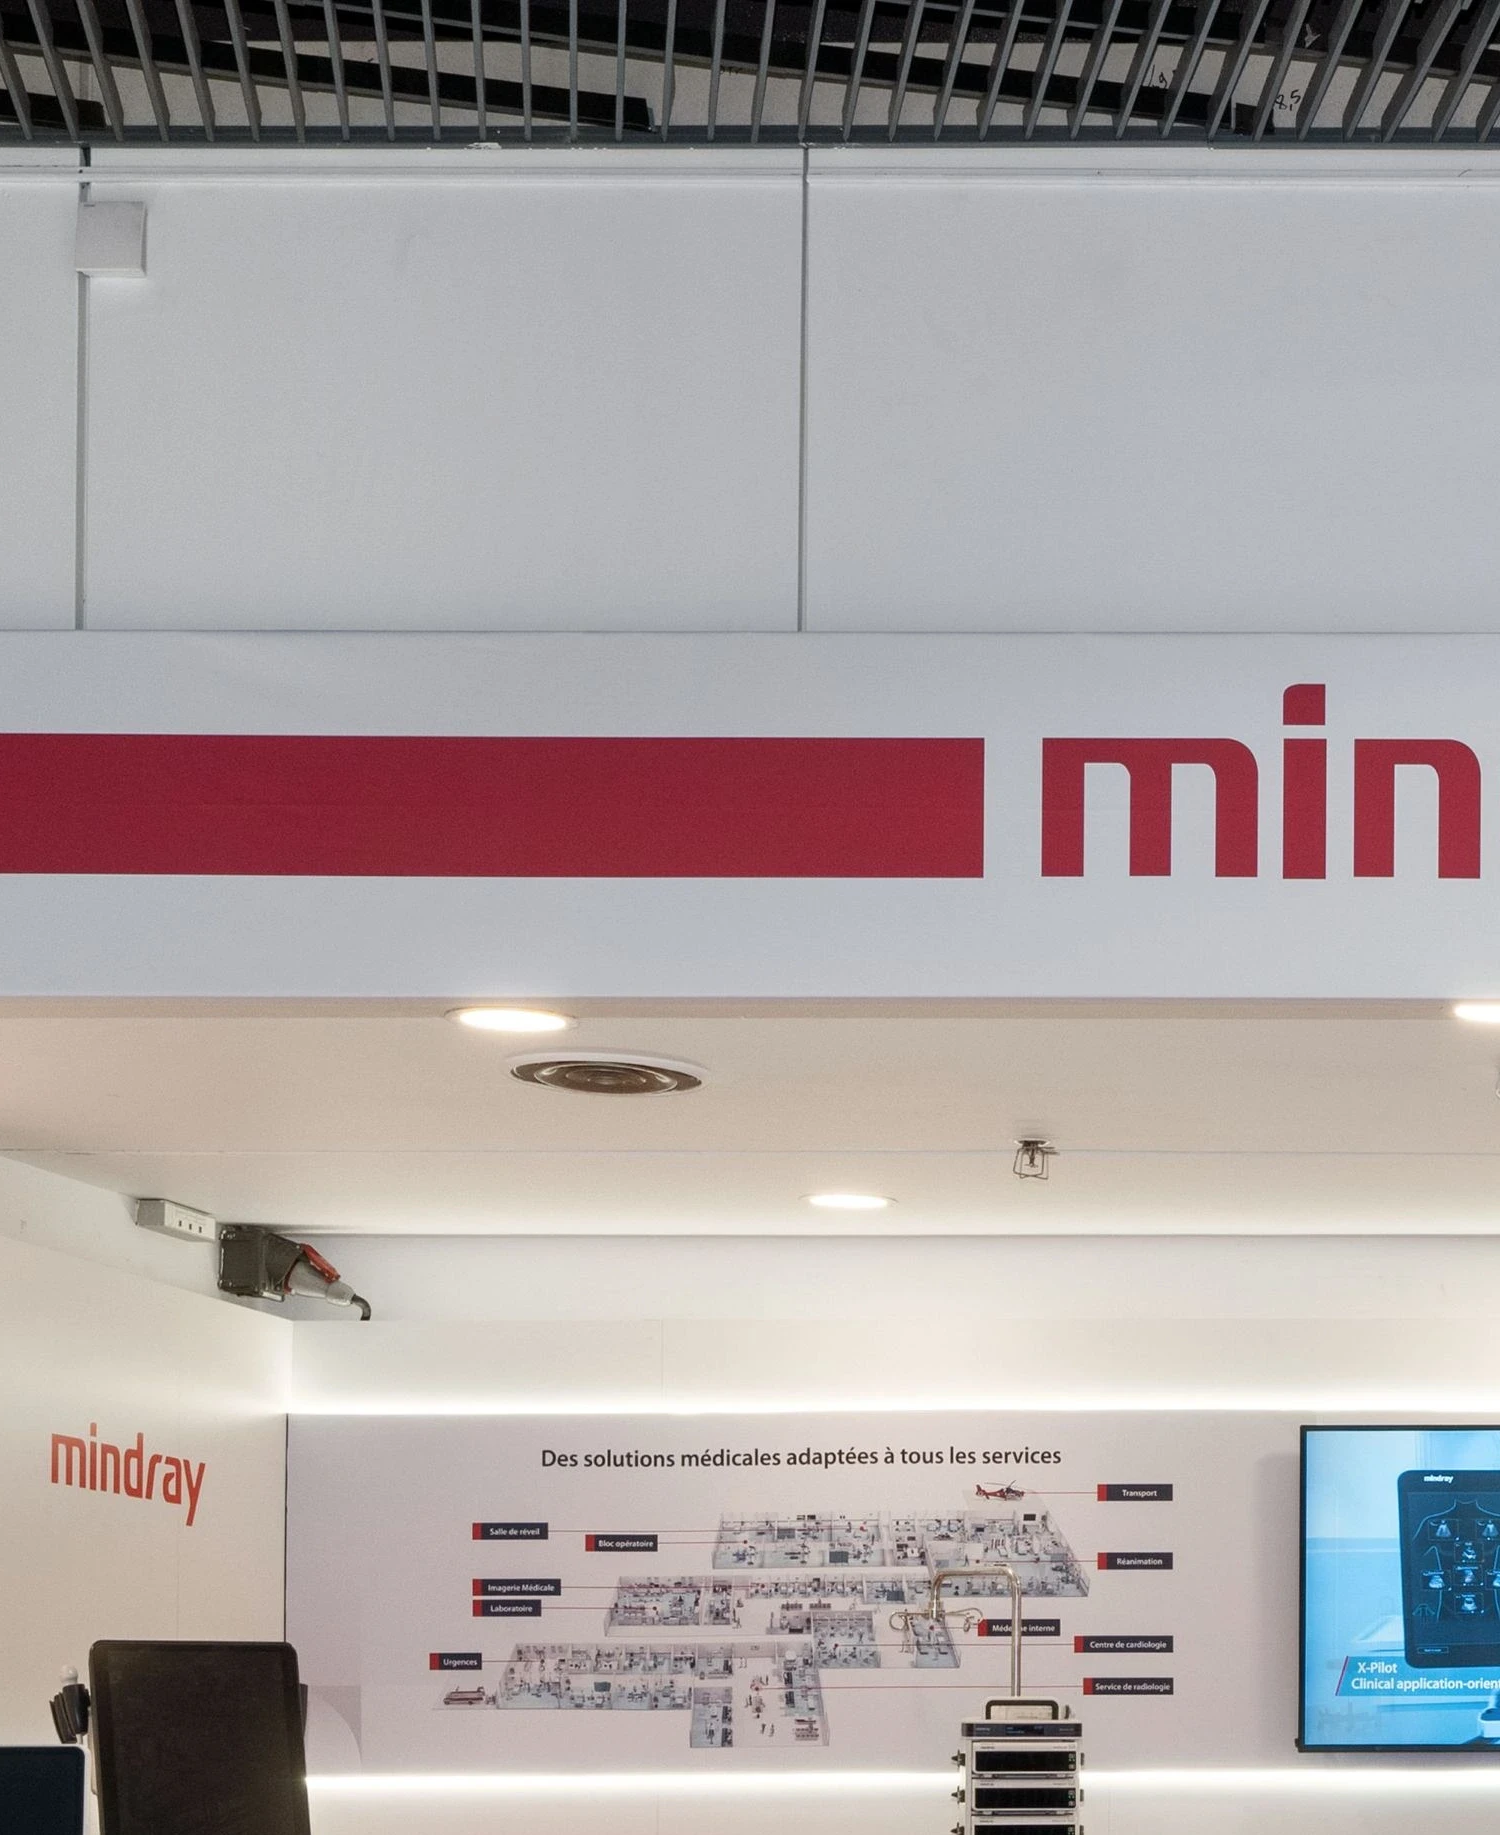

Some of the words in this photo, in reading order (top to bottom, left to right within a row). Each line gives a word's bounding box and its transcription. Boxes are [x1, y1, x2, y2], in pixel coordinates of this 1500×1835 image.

[542, 1450, 578, 1467] Des
[584, 1449, 675, 1467] solutions
[681, 1449, 780, 1466] médicales
[787, 1447, 878, 1469] adaptées
[884, 1447, 894, 1464] à
[901, 1449, 943, 1464] tous
[950, 1447, 976, 1464] les
[983, 1447, 1061, 1464] services
[51, 1423, 205, 1526] mindray
[1122, 1489, 1158, 1498] Transport
[490, 1528, 508, 1536] Salle
[509, 1528, 519, 1536] de
[520, 1527, 540, 1536] réveil
[615, 1540, 654, 1549] opératoire
[1116, 1557, 1163, 1566] Réanimation
[488, 1584, 520, 1593] Imagerie
[521, 1584, 555, 1592] Médicale
[490, 1604, 533, 1613] Laboratoire
[1028, 1624, 1055, 1632] interne
[1126, 1641, 1166, 1649] cardiologie
[443, 1658, 478, 1668] Urgences
[1357, 1662, 1398, 1674] X-Pilot
[1134, 1683, 1170, 1692] radiologie
[1351, 1678, 1395, 1690] Clinical
